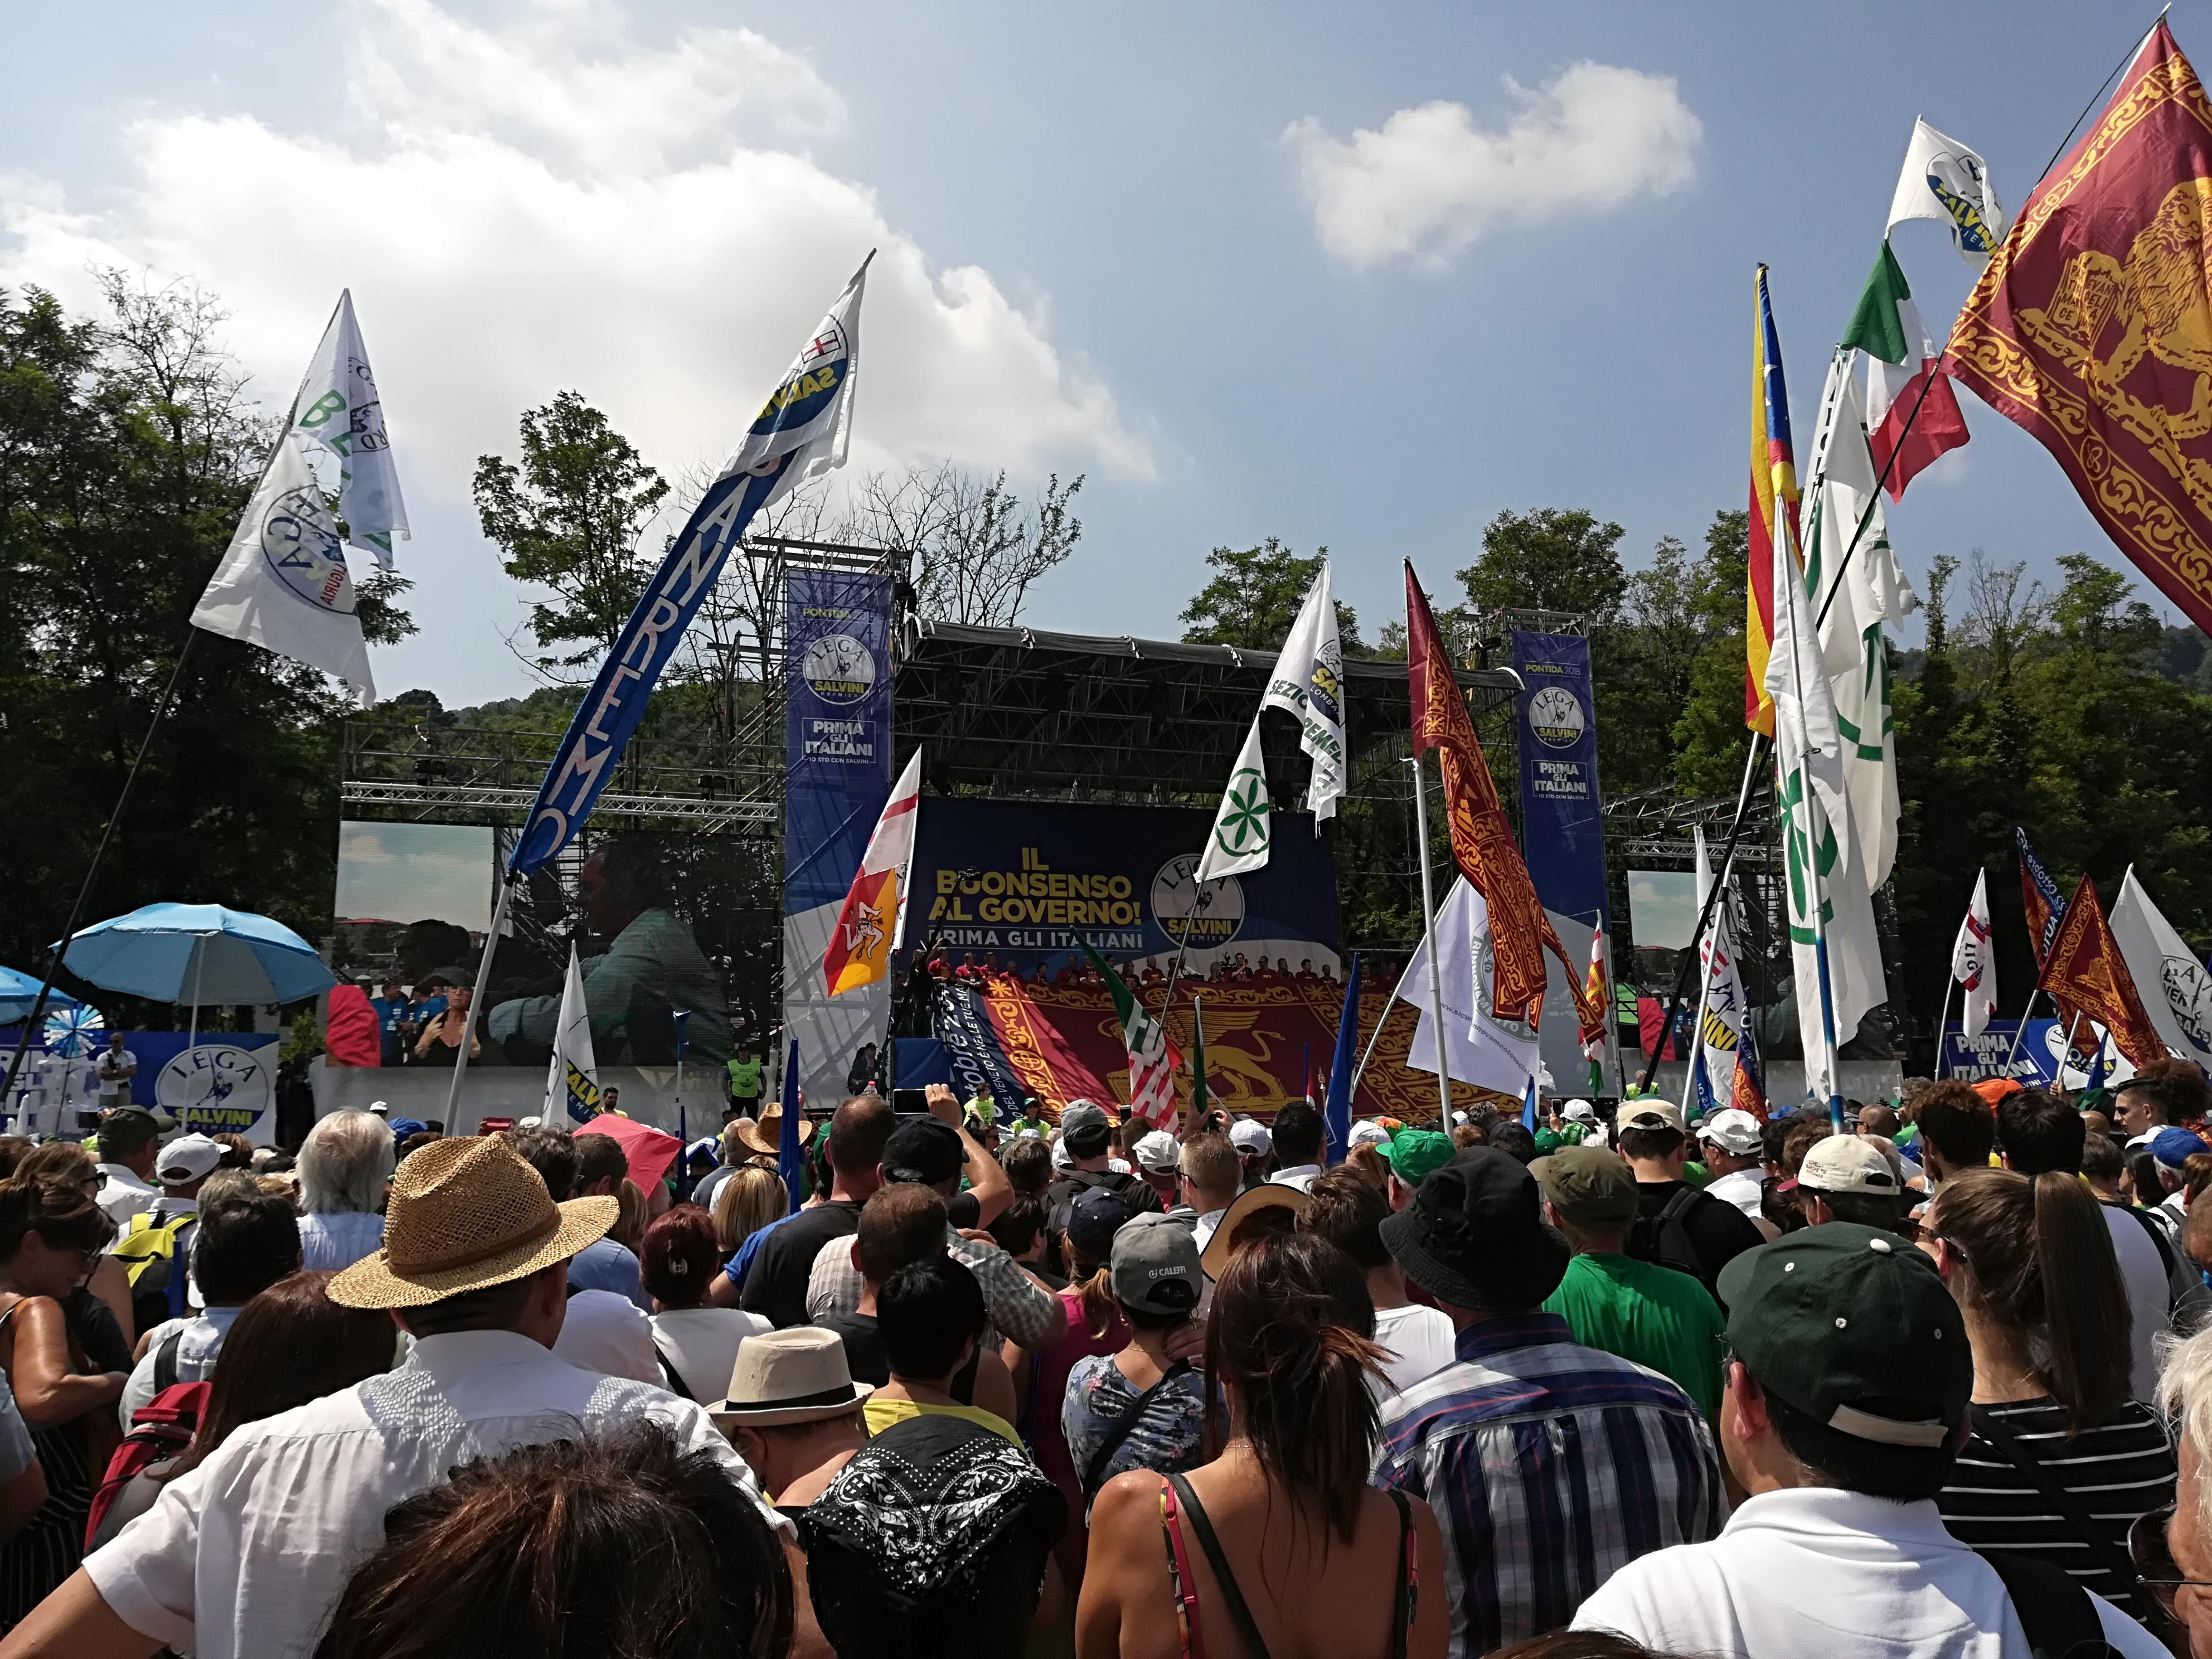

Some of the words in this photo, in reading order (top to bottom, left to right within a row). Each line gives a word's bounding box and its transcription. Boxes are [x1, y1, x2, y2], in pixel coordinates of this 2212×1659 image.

[2059, 307, 2075, 321] CE
[803, 608, 852, 619] PONTIDA
[812, 641, 865, 662] LEGA
[1526, 664, 1563, 674] PONTIDA
[1564, 666, 1580, 675] 2018
[814, 681, 865, 694] SALVINI
[1535, 691, 1574, 712] LEGA
[813, 720, 865, 735] PRIMA
[1539, 727, 1576, 739] SALVINI
[830, 734, 848, 743] GLI
[805, 741, 872, 756] ITALIANI
[1540, 762, 1579, 775] PRIMA
[1535, 780, 1587, 793] ITALIANI
[1022, 847, 1049, 871] IL
[1160, 859, 1227, 891] LEA
[928, 896, 972, 920] AL
[979, 898, 1142, 925] GOVERNO!
[1168, 919, 1232, 935] SALVINI
[1008, 931, 1042, 946] GLI
[1956, 1035, 2011, 1054] PRIMA
[1977, 1052, 1997, 1065] GLI
[983, 1060, 1008, 1093] VENETO
[1004, 1095, 1019, 1110] DEL
[174, 1108, 253, 1126] SALVINI
[1159, 1266, 1186, 1276] CALEFFI
